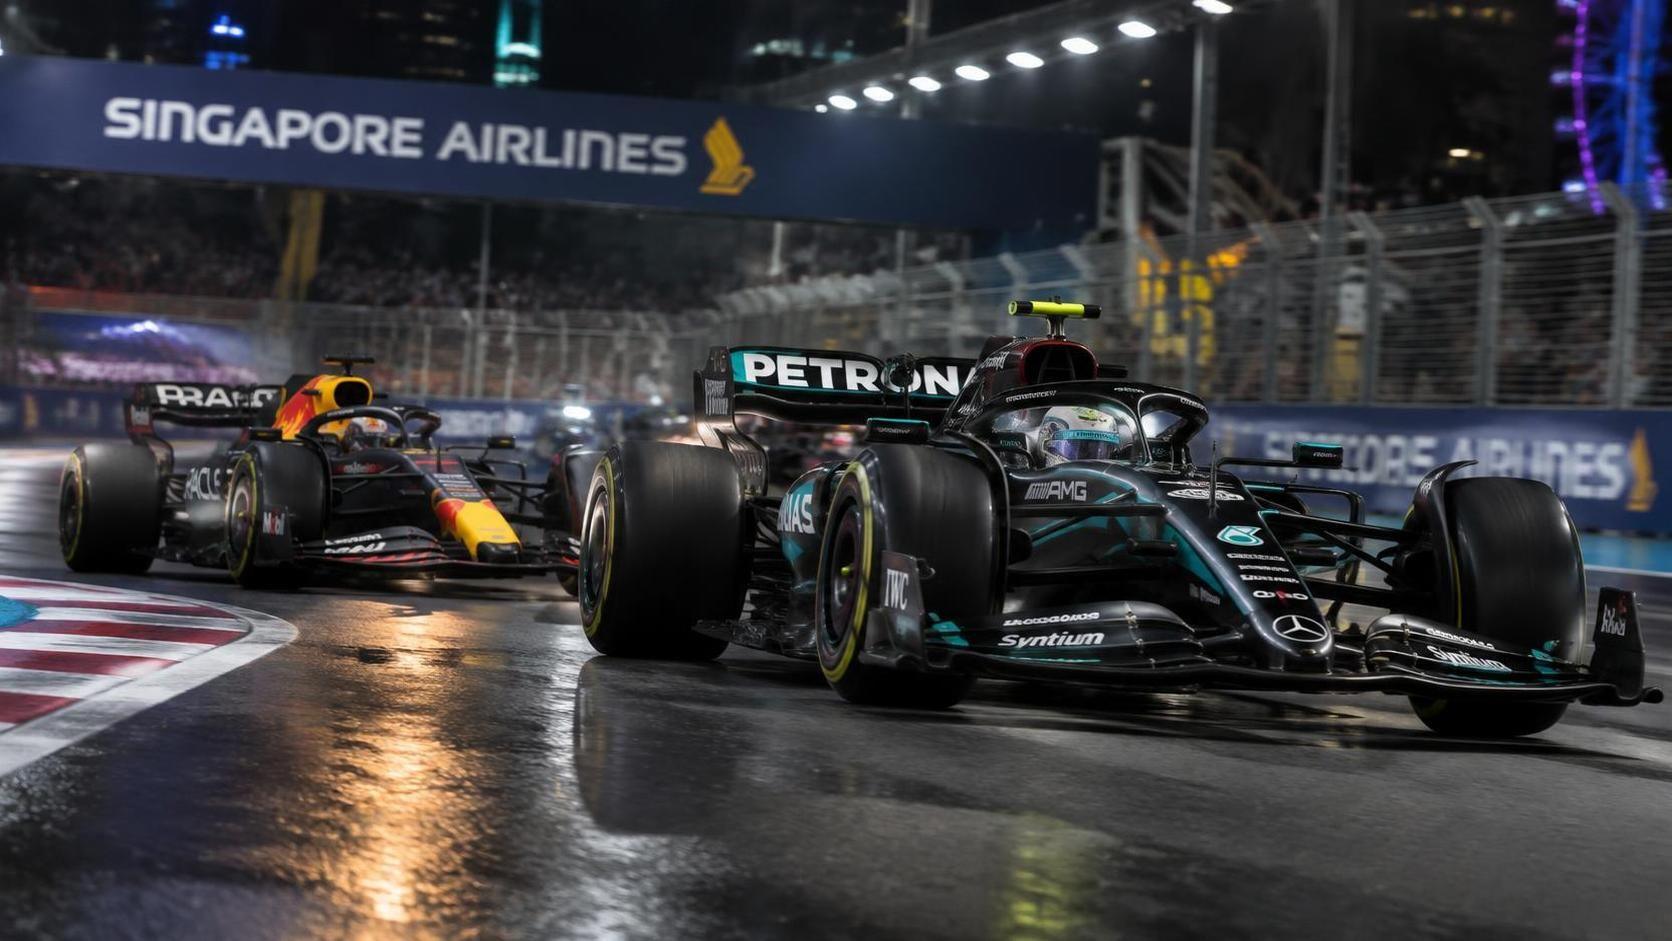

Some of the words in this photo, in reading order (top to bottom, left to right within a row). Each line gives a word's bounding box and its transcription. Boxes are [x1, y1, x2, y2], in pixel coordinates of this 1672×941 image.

[103, 97, 424, 158] SINGAPORE
[437, 121, 686, 174] AIRLINES
[1047, 480, 1087, 501] AMG
[885, 568, 909, 610] IWC
[998, 631, 1105, 648] Syntium
